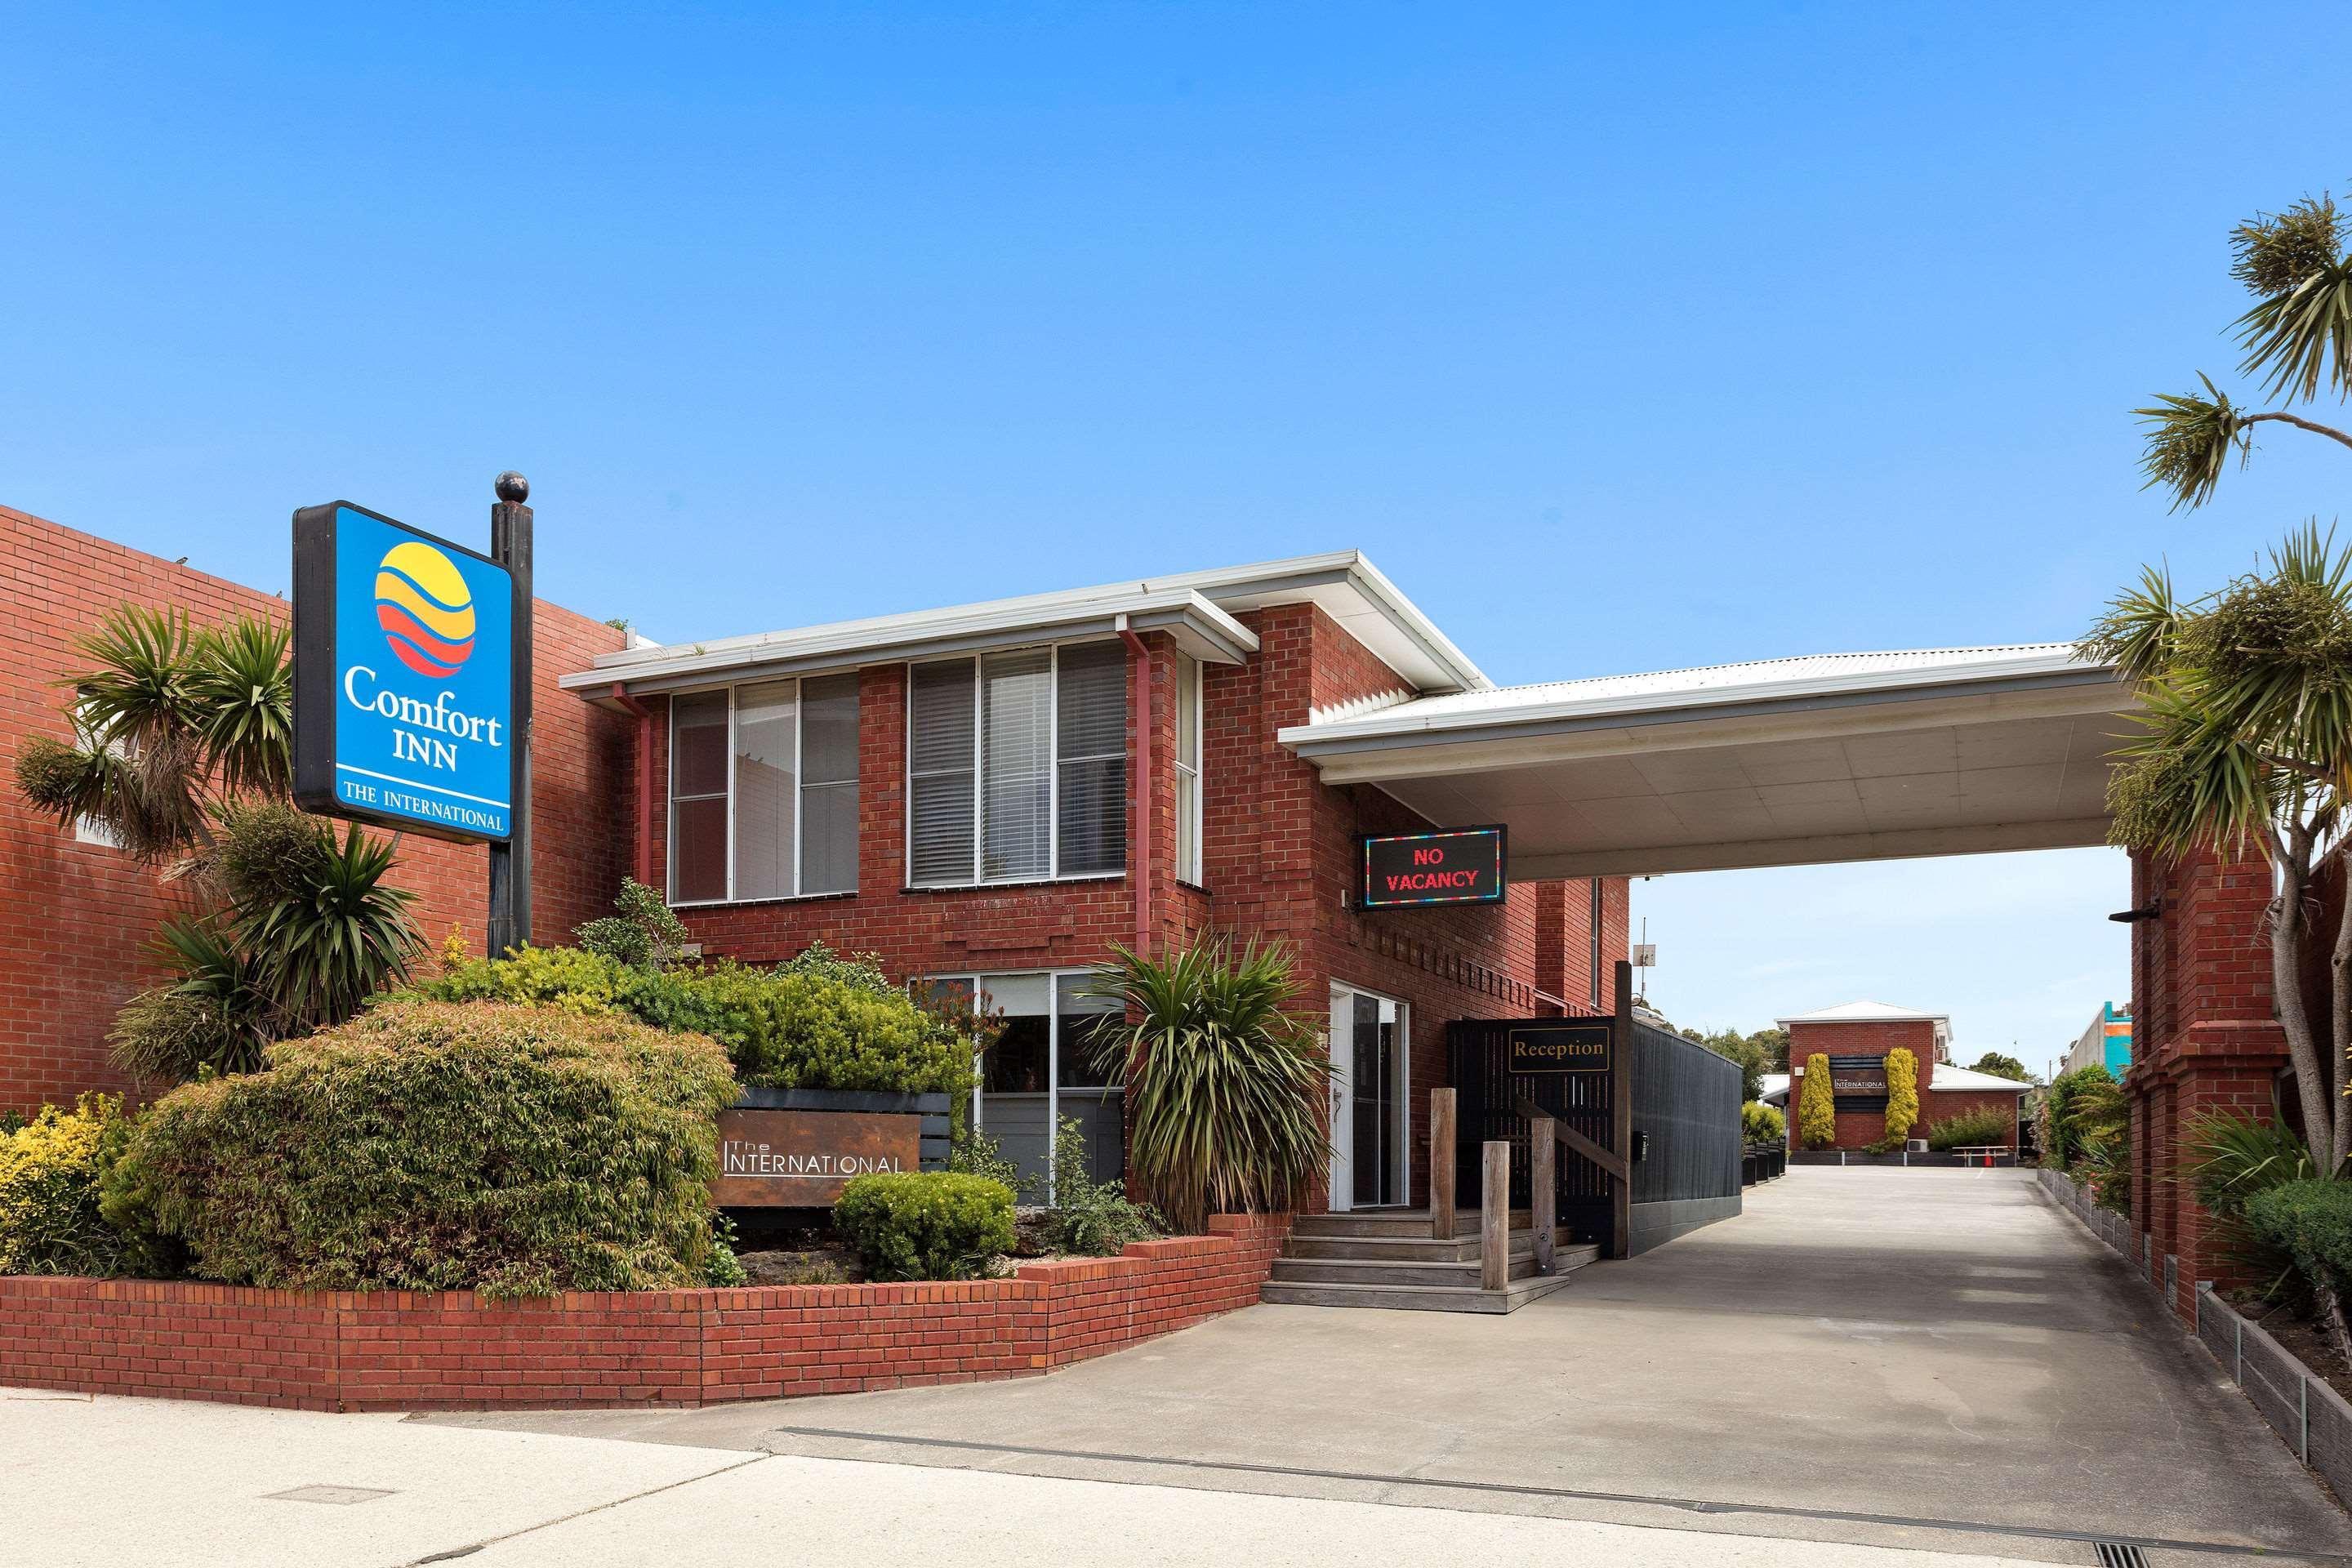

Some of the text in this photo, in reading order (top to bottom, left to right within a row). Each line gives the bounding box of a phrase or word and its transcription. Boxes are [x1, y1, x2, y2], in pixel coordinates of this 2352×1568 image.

[344, 665, 503, 747] Comfort
[392, 728, 458, 772] INN
[344, 781, 505, 831] THE INTERNATIONAL
[1413, 849, 1444, 866] NO
[1386, 870, 1479, 891] VACANCY
[1515, 1040, 1604, 1060] Reception
[1834, 1079, 1886, 1088] INTERNATIONAL
[729, 1141, 770, 1151] The
[724, 1141, 903, 1174] INTERNATIONAL
